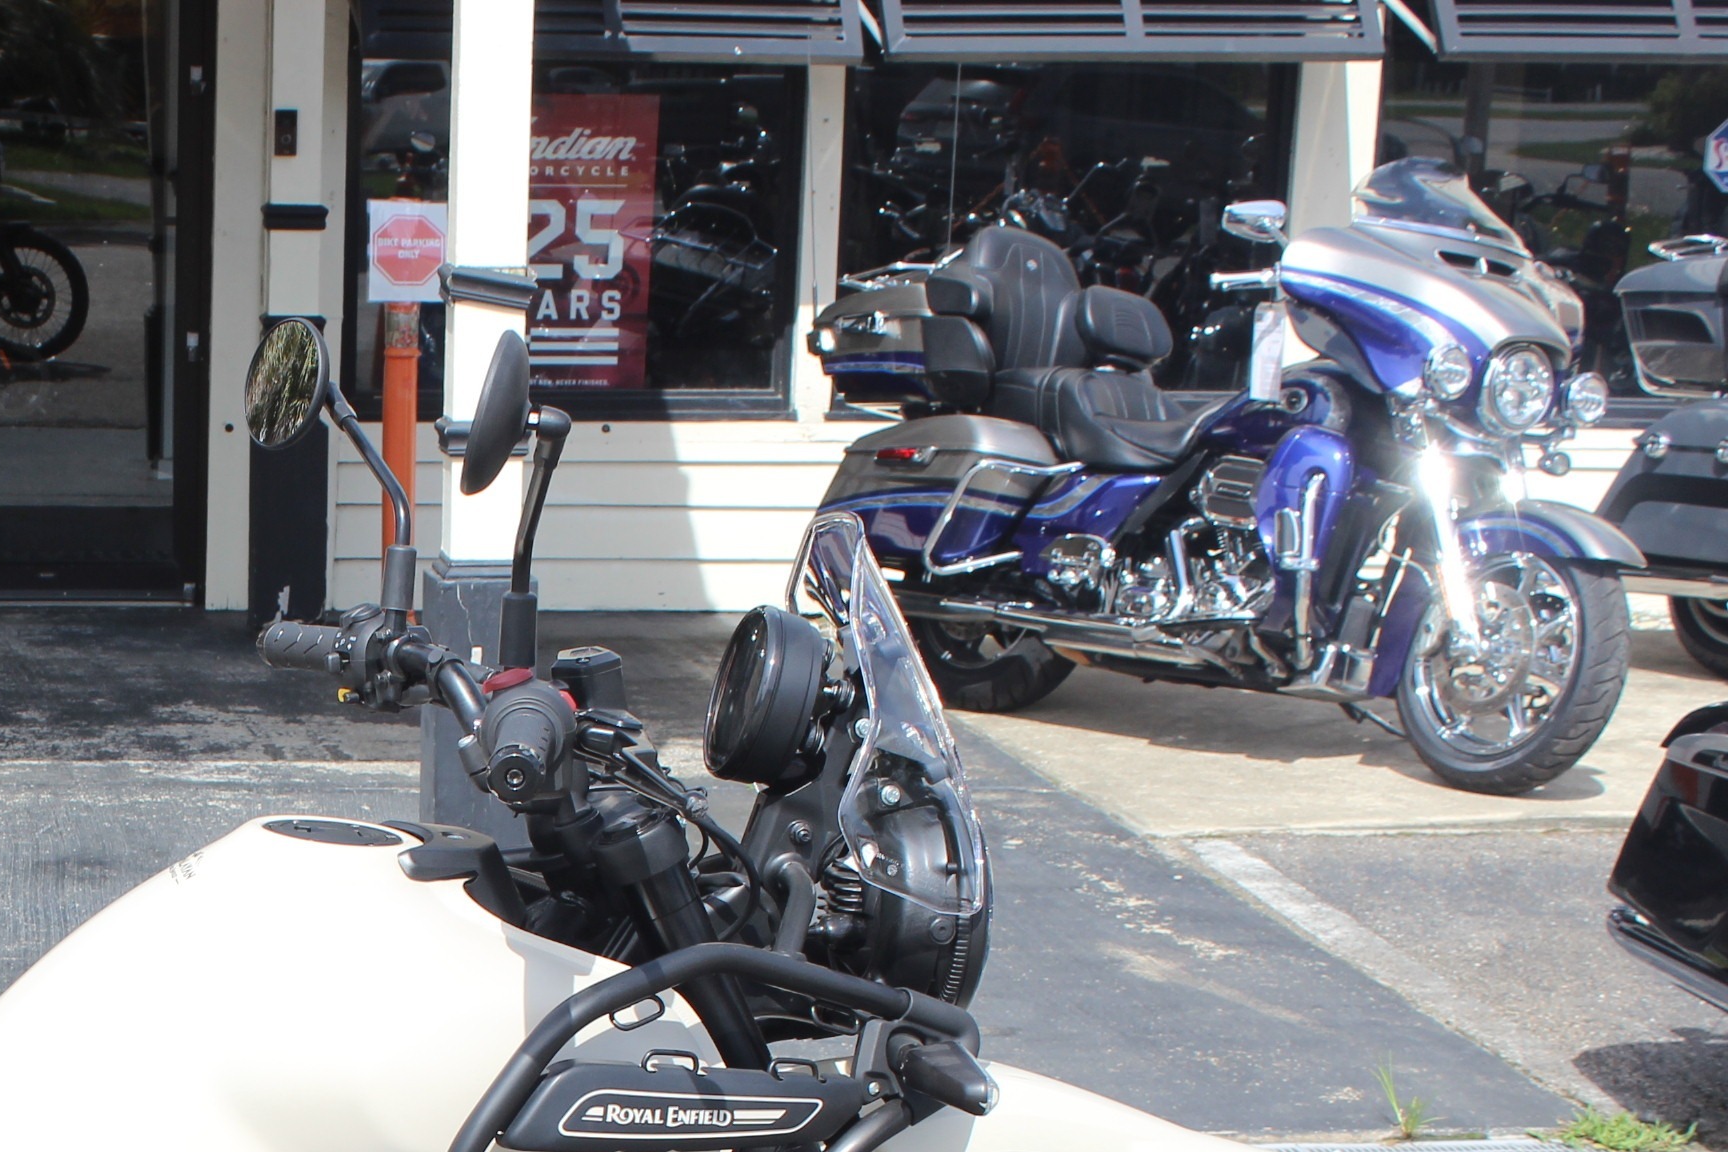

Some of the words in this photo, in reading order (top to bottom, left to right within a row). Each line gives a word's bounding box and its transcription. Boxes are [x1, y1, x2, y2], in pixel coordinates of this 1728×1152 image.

[530, 117, 637, 160] ndian
[530, 165, 629, 177] ORCYCLE
[401, 238, 441, 248] PARKING
[529, 199, 626, 280] 25
[398, 250, 421, 259] ONLY
[536, 289, 622, 321] ARS
[606, 1104, 665, 1125] ROYAL
[666, 1106, 732, 1127] ENFIELD
